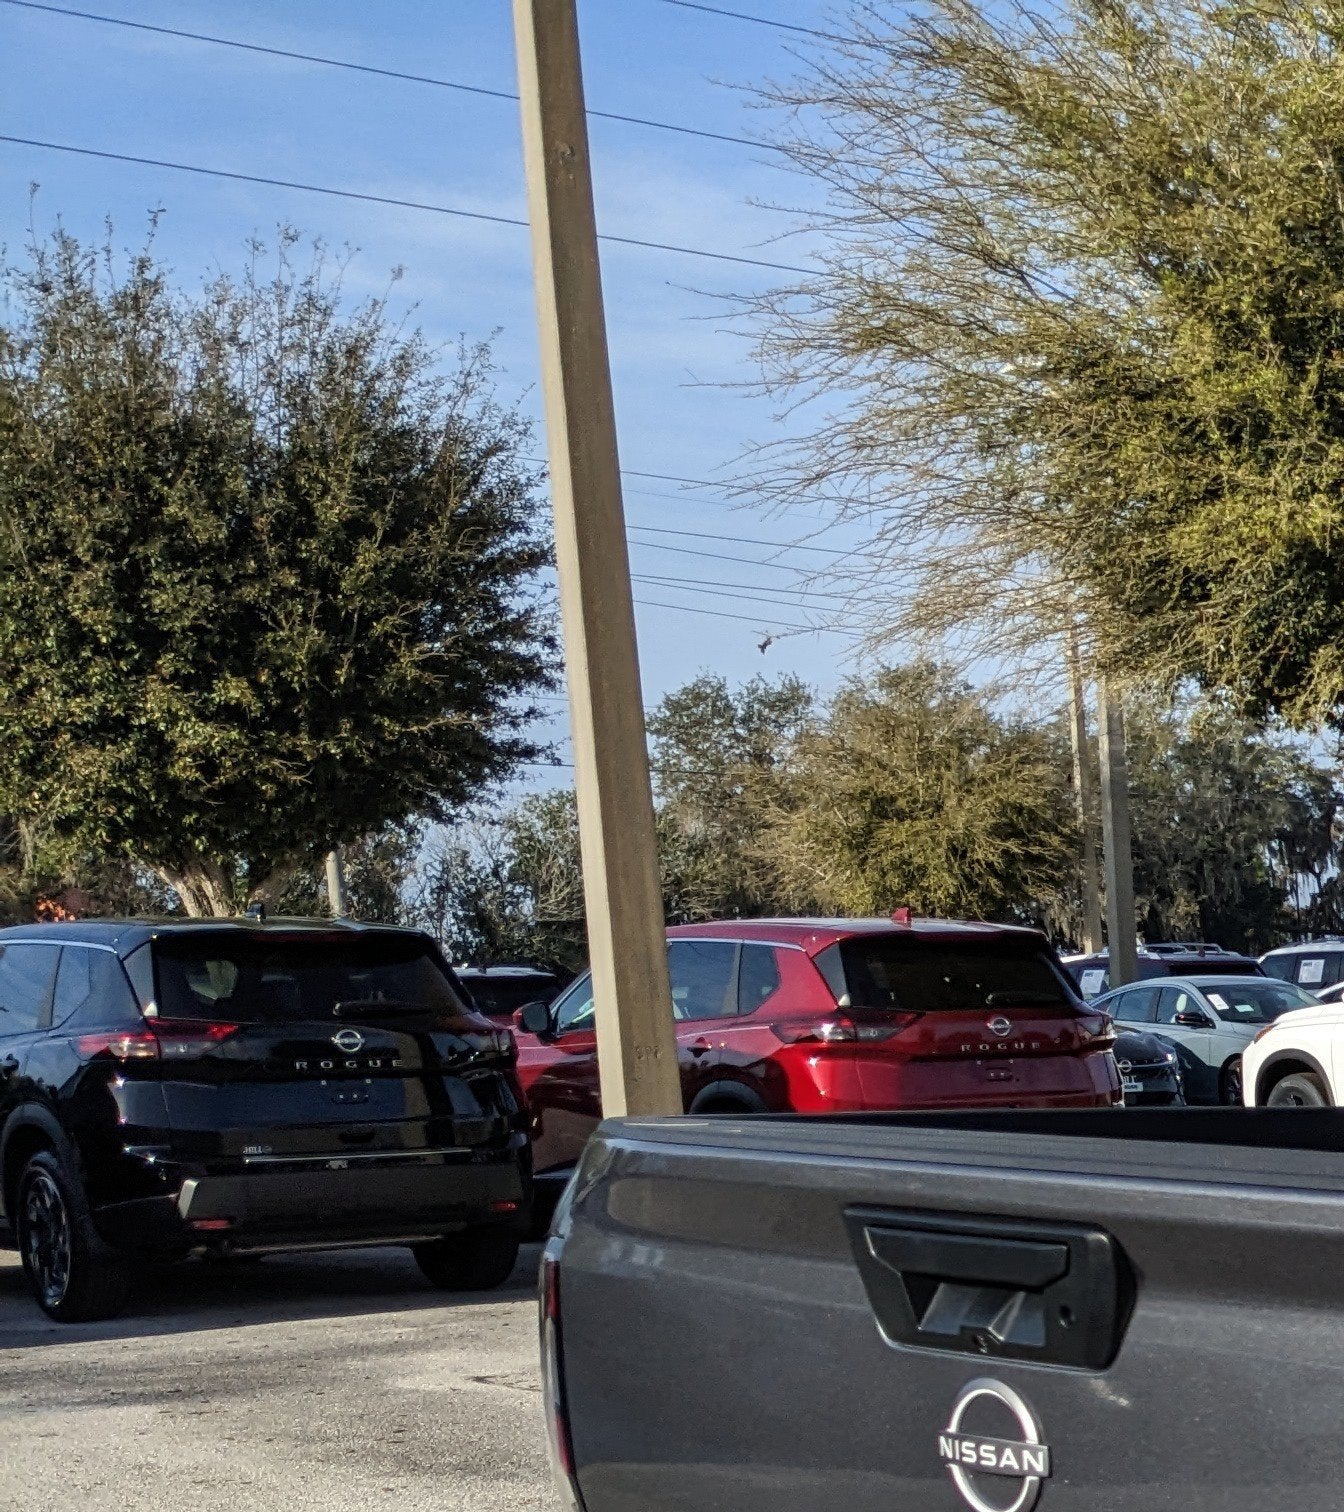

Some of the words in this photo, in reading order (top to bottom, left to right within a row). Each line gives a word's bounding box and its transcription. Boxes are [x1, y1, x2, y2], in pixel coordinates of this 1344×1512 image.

[962, 1042, 1041, 1052] ROGUE
[295, 1060, 404, 1070] ROGUE
[938, 1435, 1044, 1472] NISSAN
